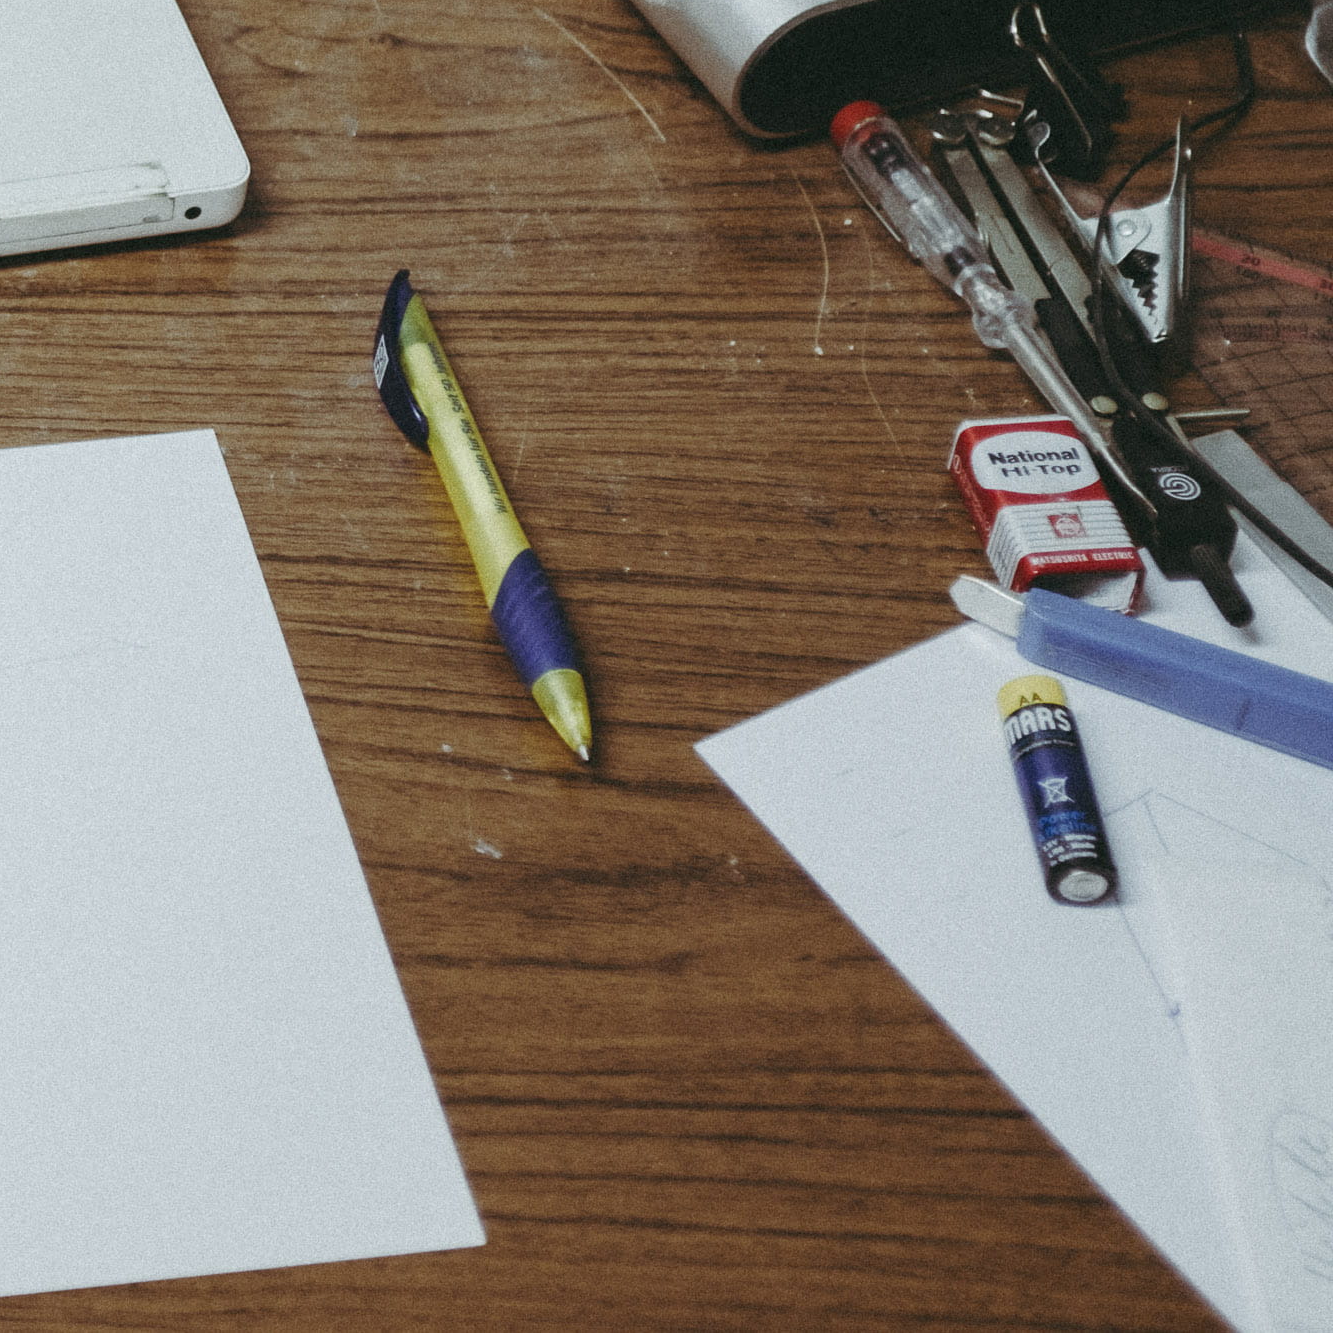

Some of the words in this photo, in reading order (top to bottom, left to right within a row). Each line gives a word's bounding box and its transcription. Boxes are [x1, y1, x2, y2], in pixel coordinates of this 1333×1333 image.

[987, 447, 1081, 465] National
[1092, 550, 1135, 562] ELECTRIC
[1019, 692, 1044, 707] AA
